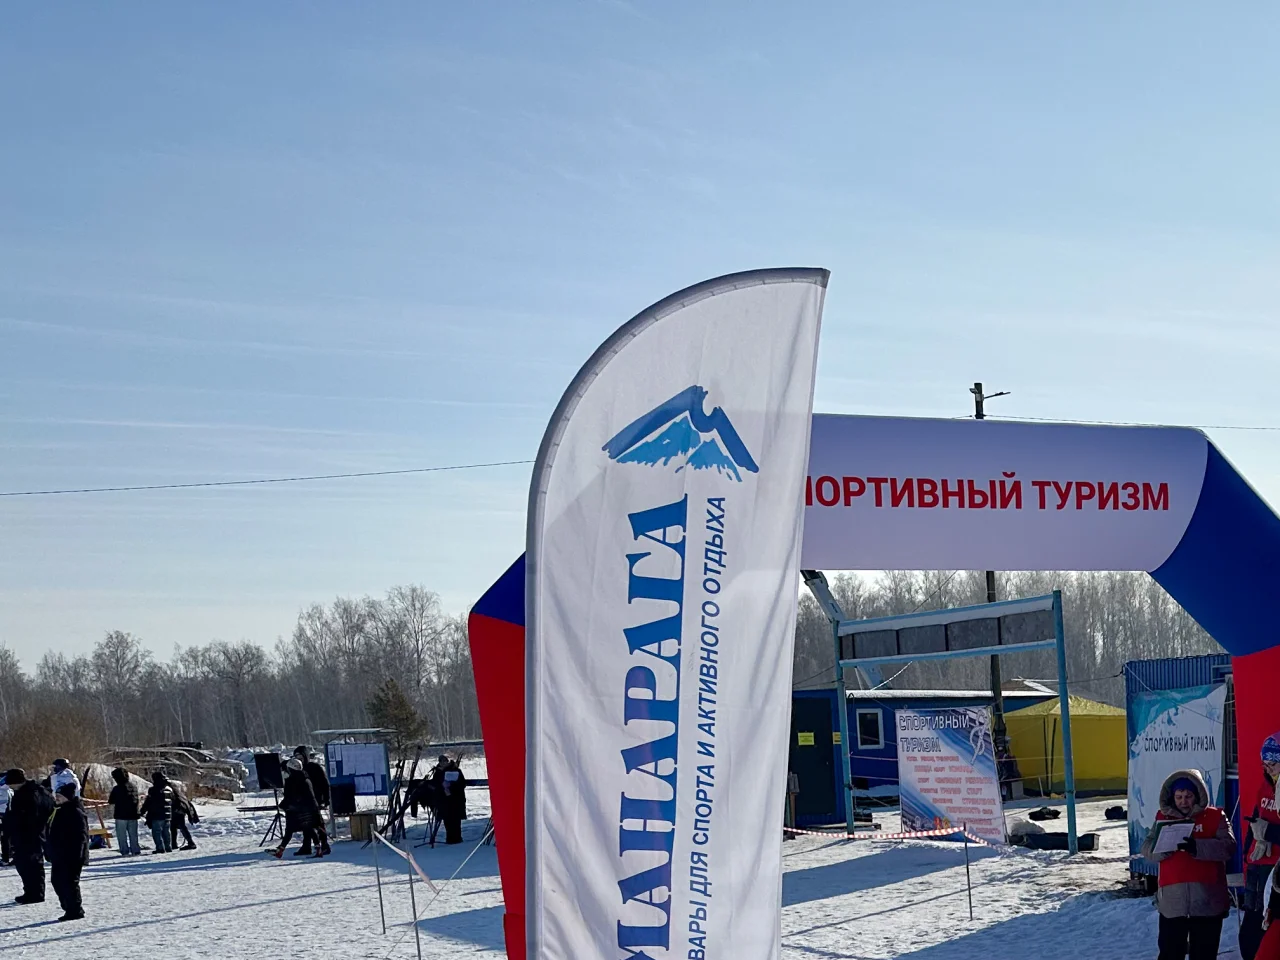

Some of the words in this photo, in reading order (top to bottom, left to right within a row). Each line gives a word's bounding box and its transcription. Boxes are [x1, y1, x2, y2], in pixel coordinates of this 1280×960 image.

[805, 471, 1022, 510] ОРТИВНЫЙ
[1031, 480, 1169, 511] ТУРИЗМ
[702, 497, 727, 594] ОТДЫХА
[697, 600, 720, 738] АКТИВНОГО
[899, 712, 970, 731] СПОРТИВНЫЙ
[697, 740, 715, 758] И
[899, 737, 942, 752] ТУРИЗМ
[1144, 733, 1189, 752] СПОРТИВНЫЙ
[1191, 735, 1216, 751] ТУРИЗМ
[692, 764, 715, 846] СПОРТА
[1261, 798, 1277, 812] СУДЬ
[689, 851, 713, 898] ДЛЯ
